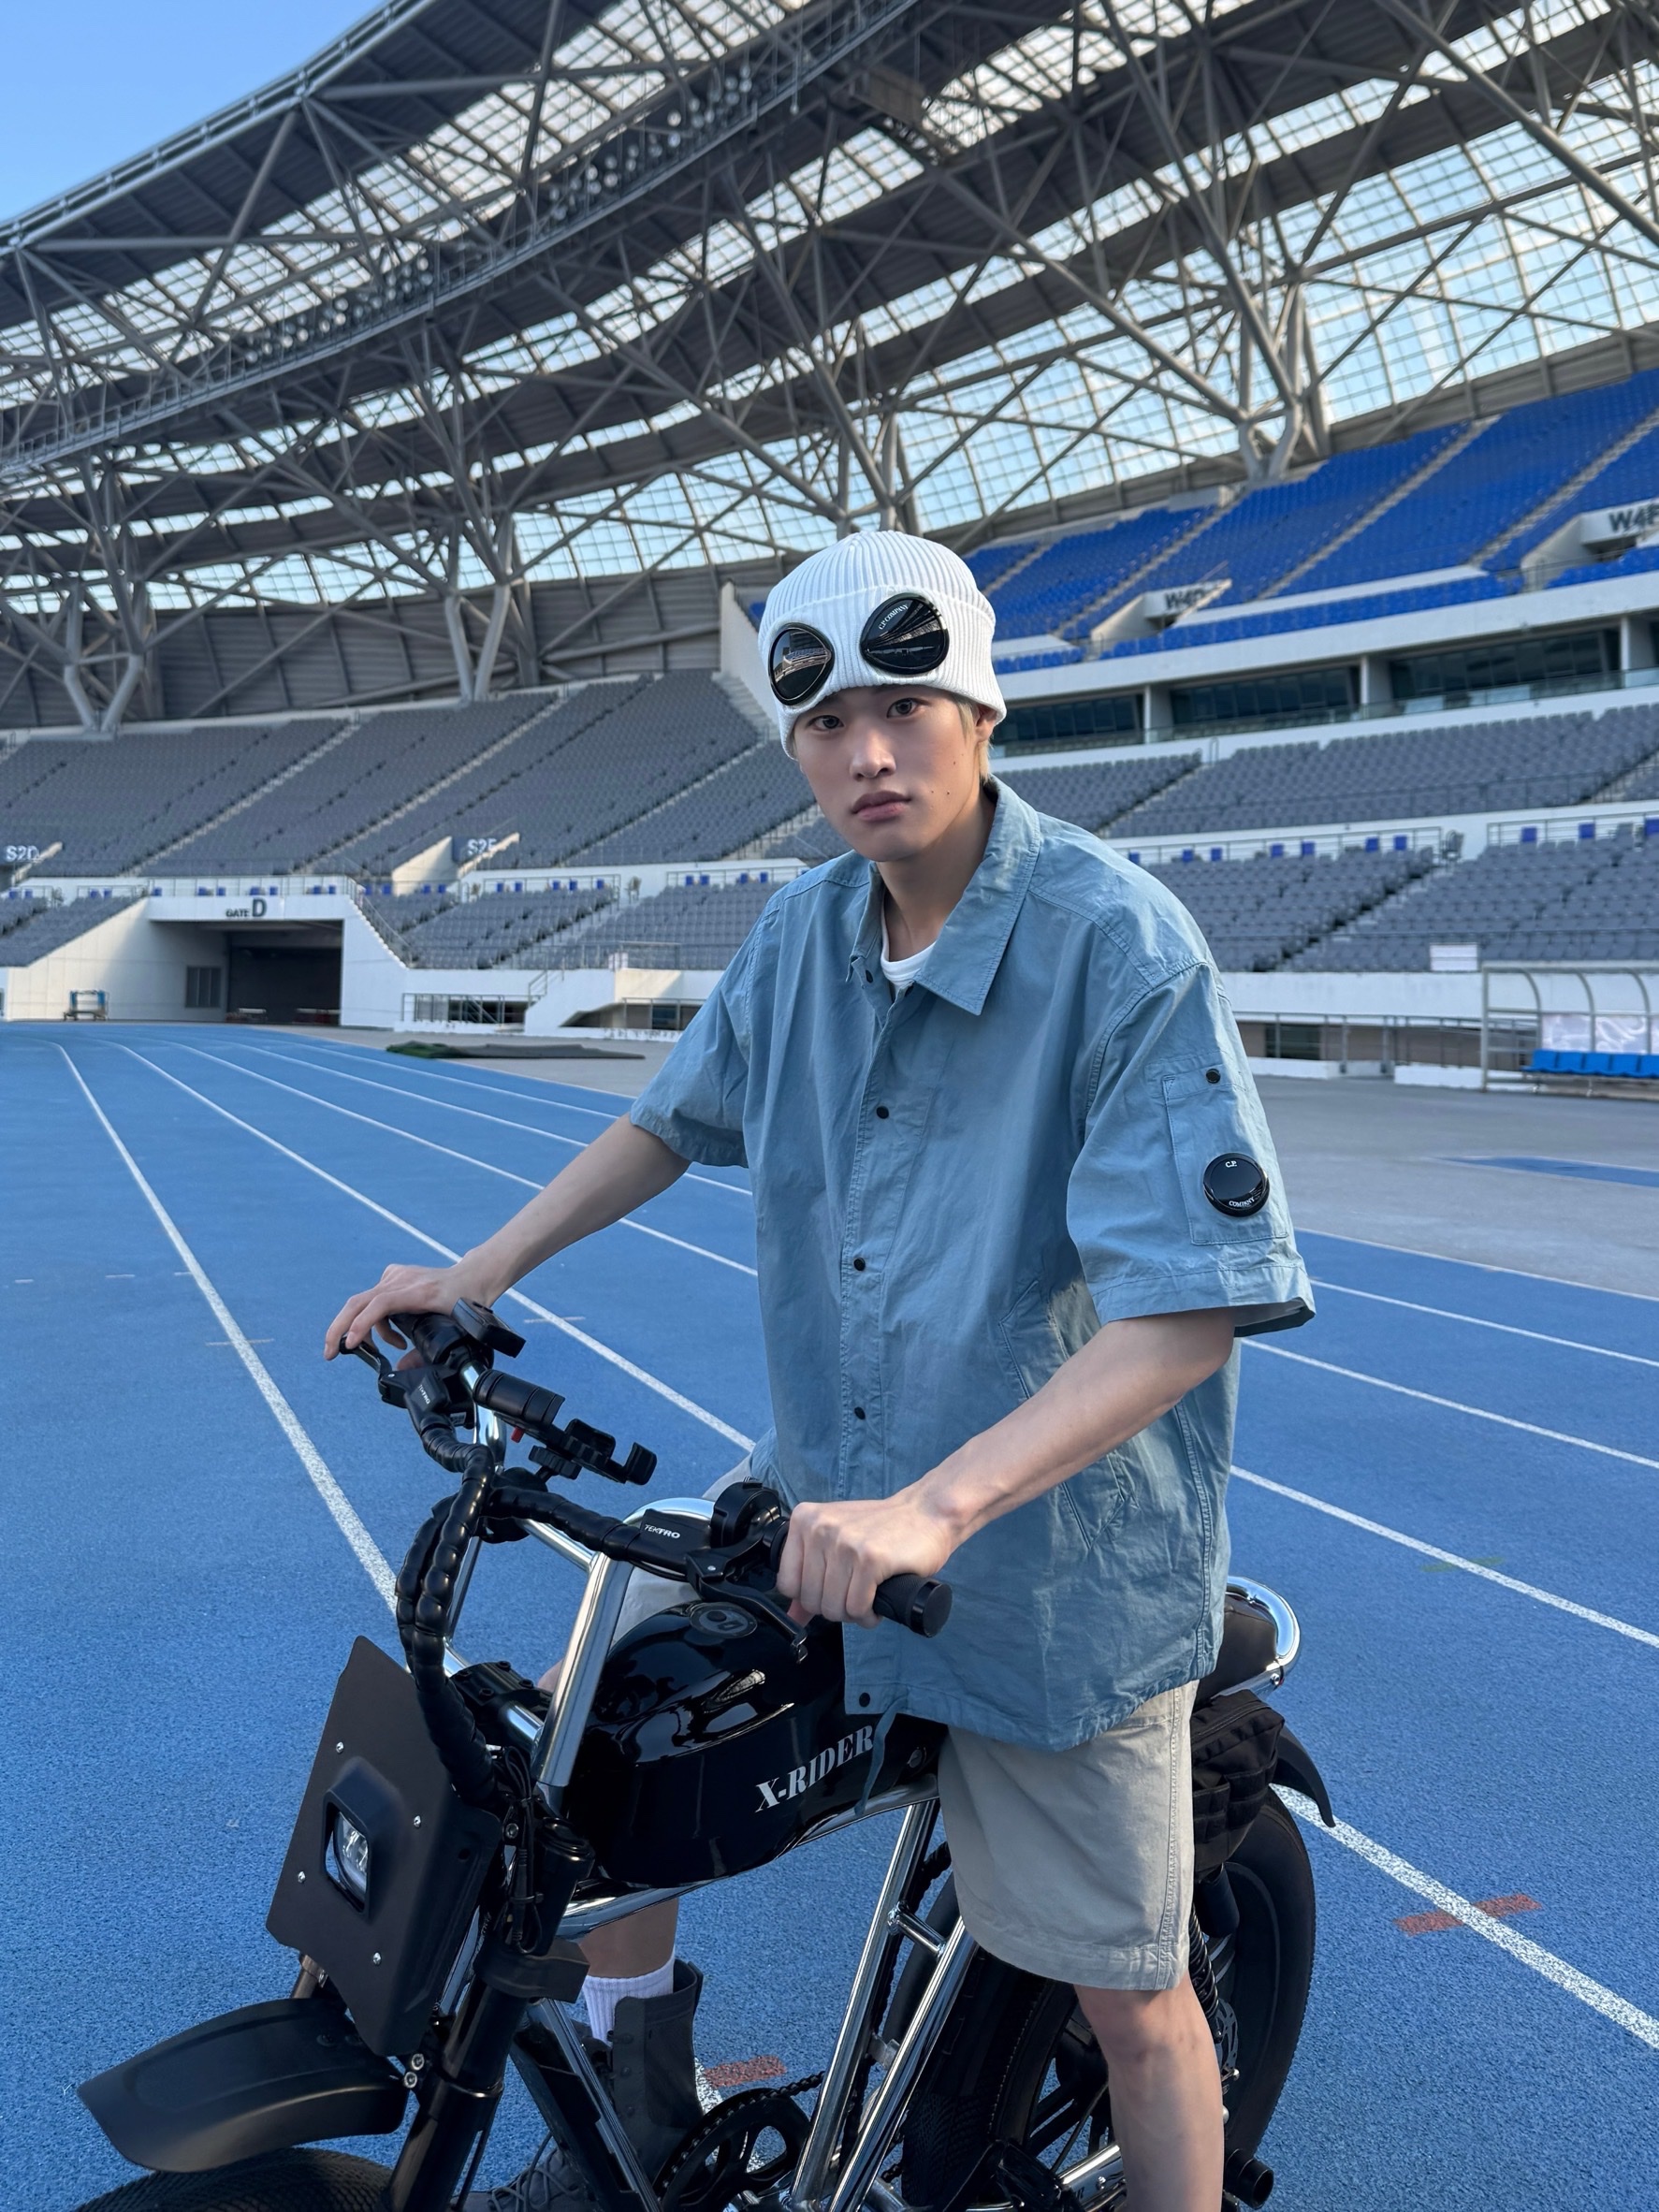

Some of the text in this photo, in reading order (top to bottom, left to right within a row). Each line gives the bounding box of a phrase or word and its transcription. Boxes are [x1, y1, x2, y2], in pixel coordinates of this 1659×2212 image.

[226, 897, 268, 917] GATE D
[644, 1523, 681, 1539] TEKTRO
[754, 1724, 873, 1813] X-RIDER
